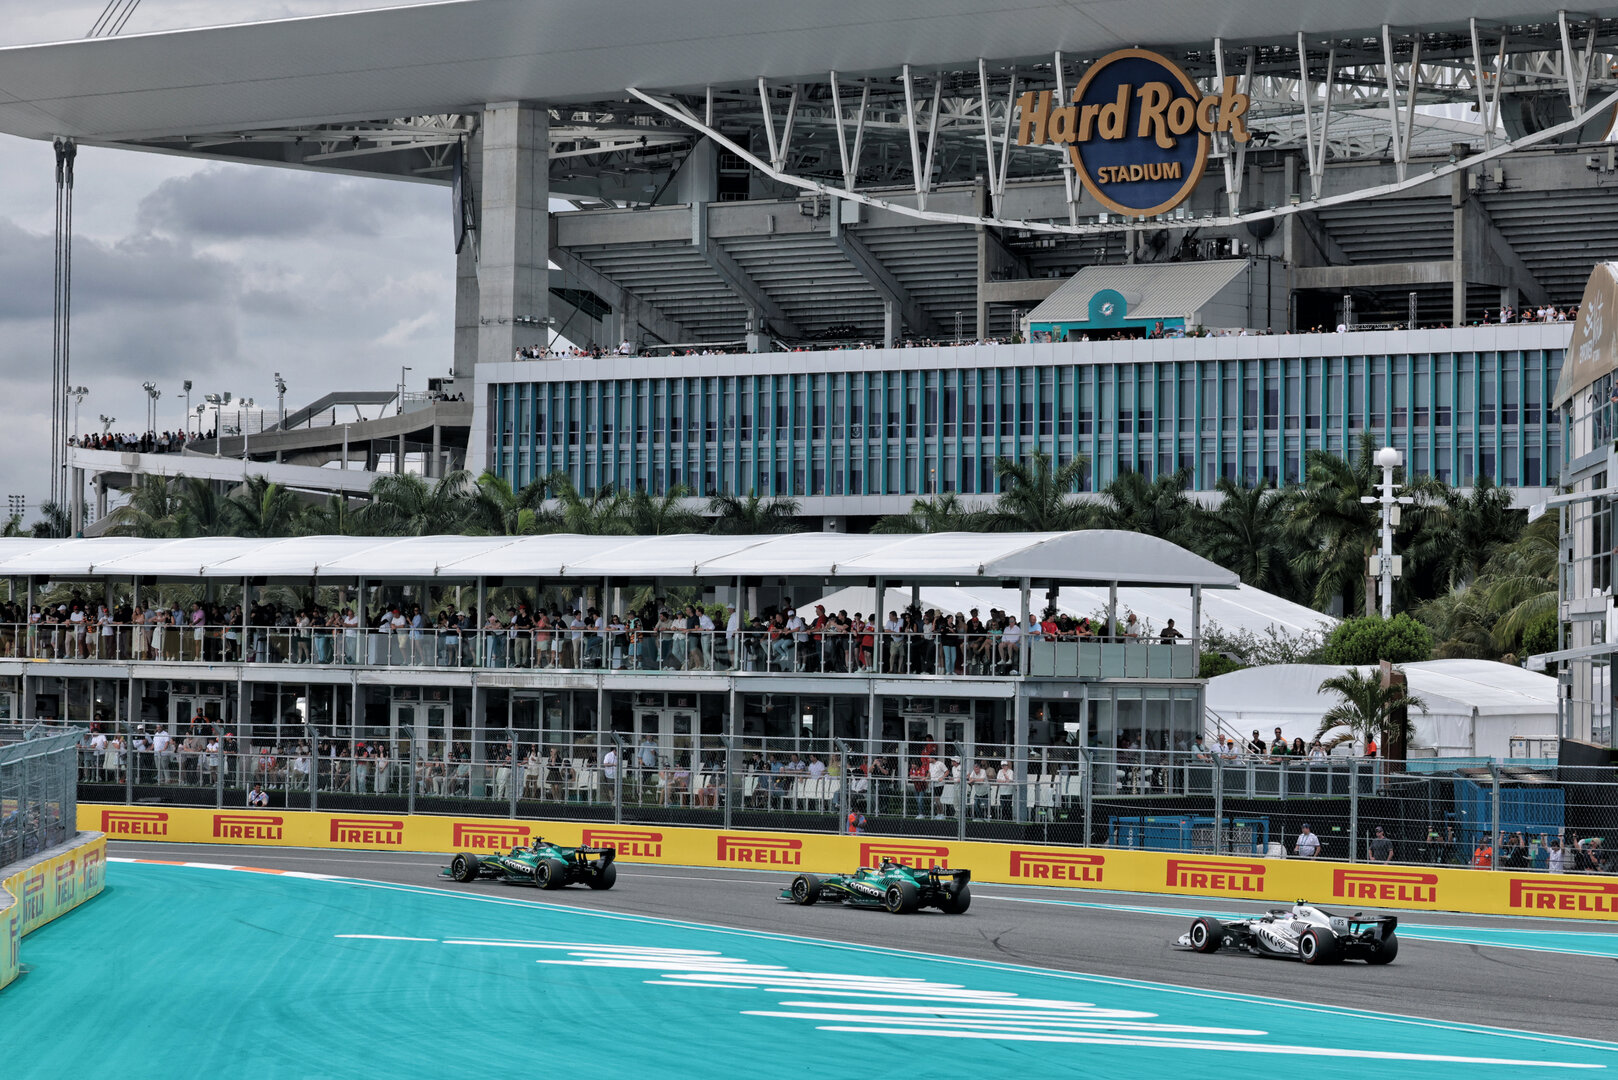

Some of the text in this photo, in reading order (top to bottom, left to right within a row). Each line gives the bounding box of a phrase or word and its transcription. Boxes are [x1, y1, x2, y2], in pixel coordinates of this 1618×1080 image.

[1016, 76, 1250, 149] Hard Rock
[1098, 161, 1182, 184] STADIUM
[102, 811, 168, 835] PIRELLI
[213, 815, 283, 839] PIRELLI
[330, 819, 403, 844] PIRELLI
[453, 823, 531, 849] PIRELLI
[718, 836, 802, 864] PIRELLI
[504, 859, 531, 873] aramco
[1010, 851, 1104, 881] PIRELLI
[1167, 860, 1265, 891] PIRELLI
[850, 881, 880, 897] aramco
[1333, 870, 1438, 902] PIRELLI
[1509, 878, 1618, 913] PIRELLI
